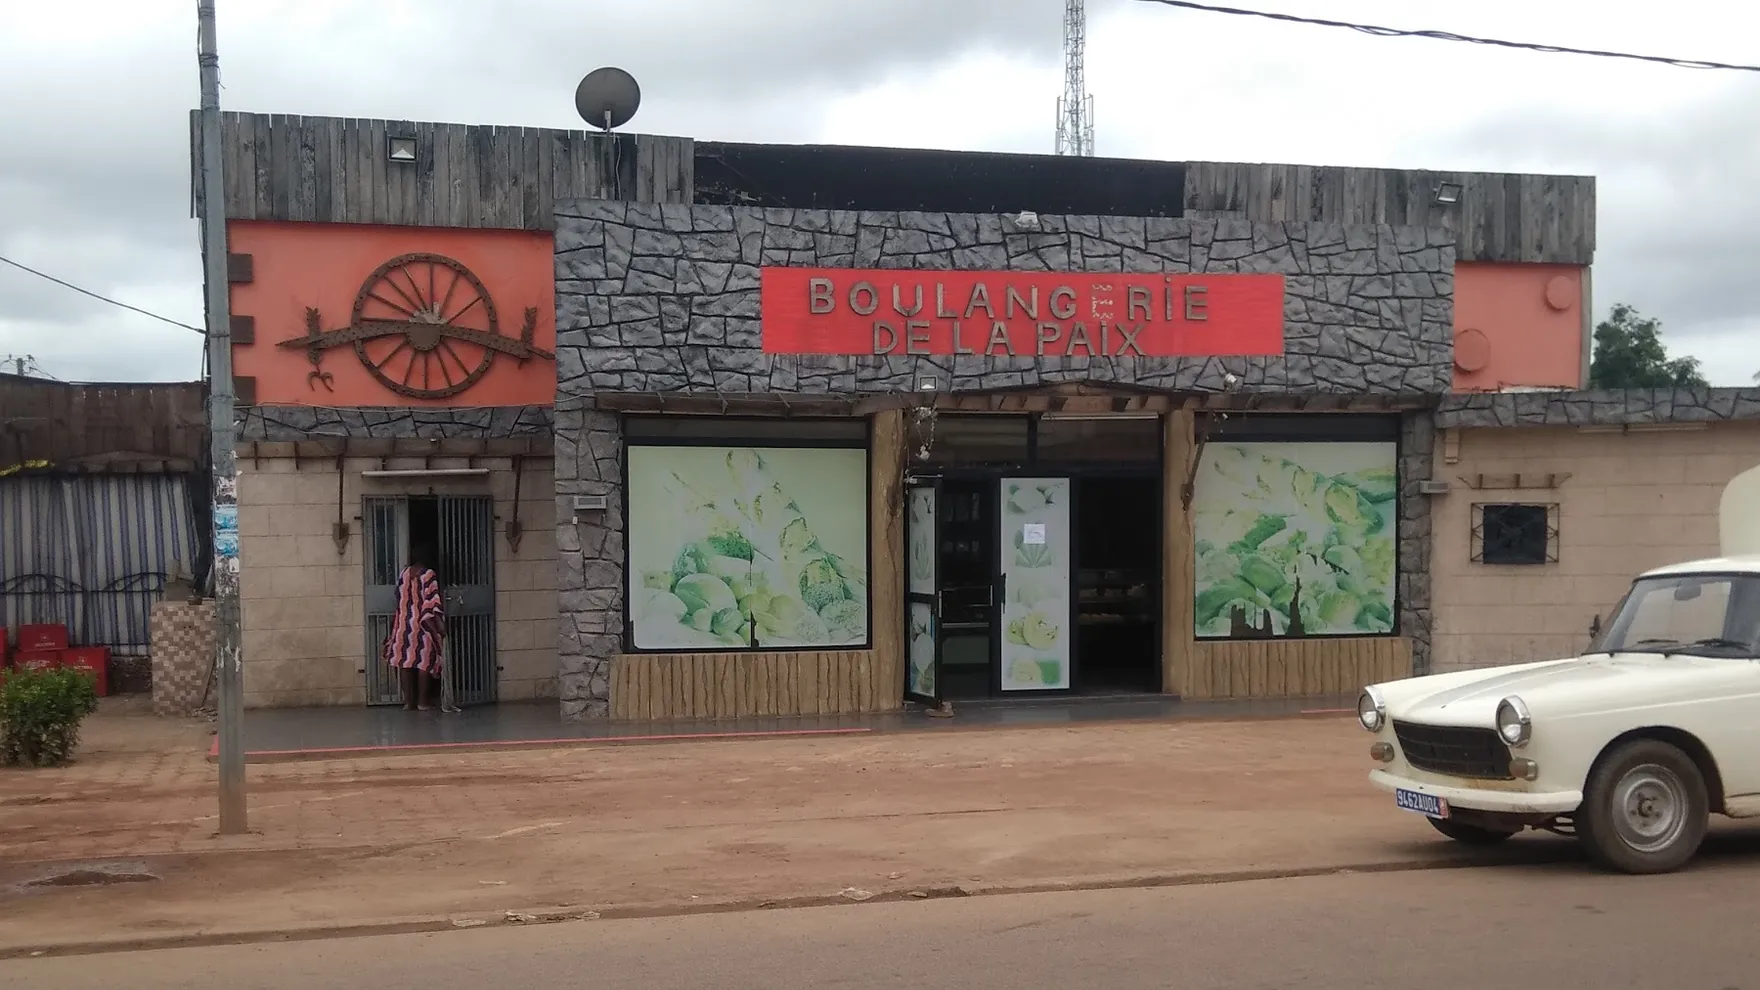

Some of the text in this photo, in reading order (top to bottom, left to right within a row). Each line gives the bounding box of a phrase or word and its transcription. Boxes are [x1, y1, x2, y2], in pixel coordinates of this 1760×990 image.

[873, 320, 931, 356] DE
[953, 320, 1016, 356] LA
[1397, 790, 1439, 814] 9462AU04
